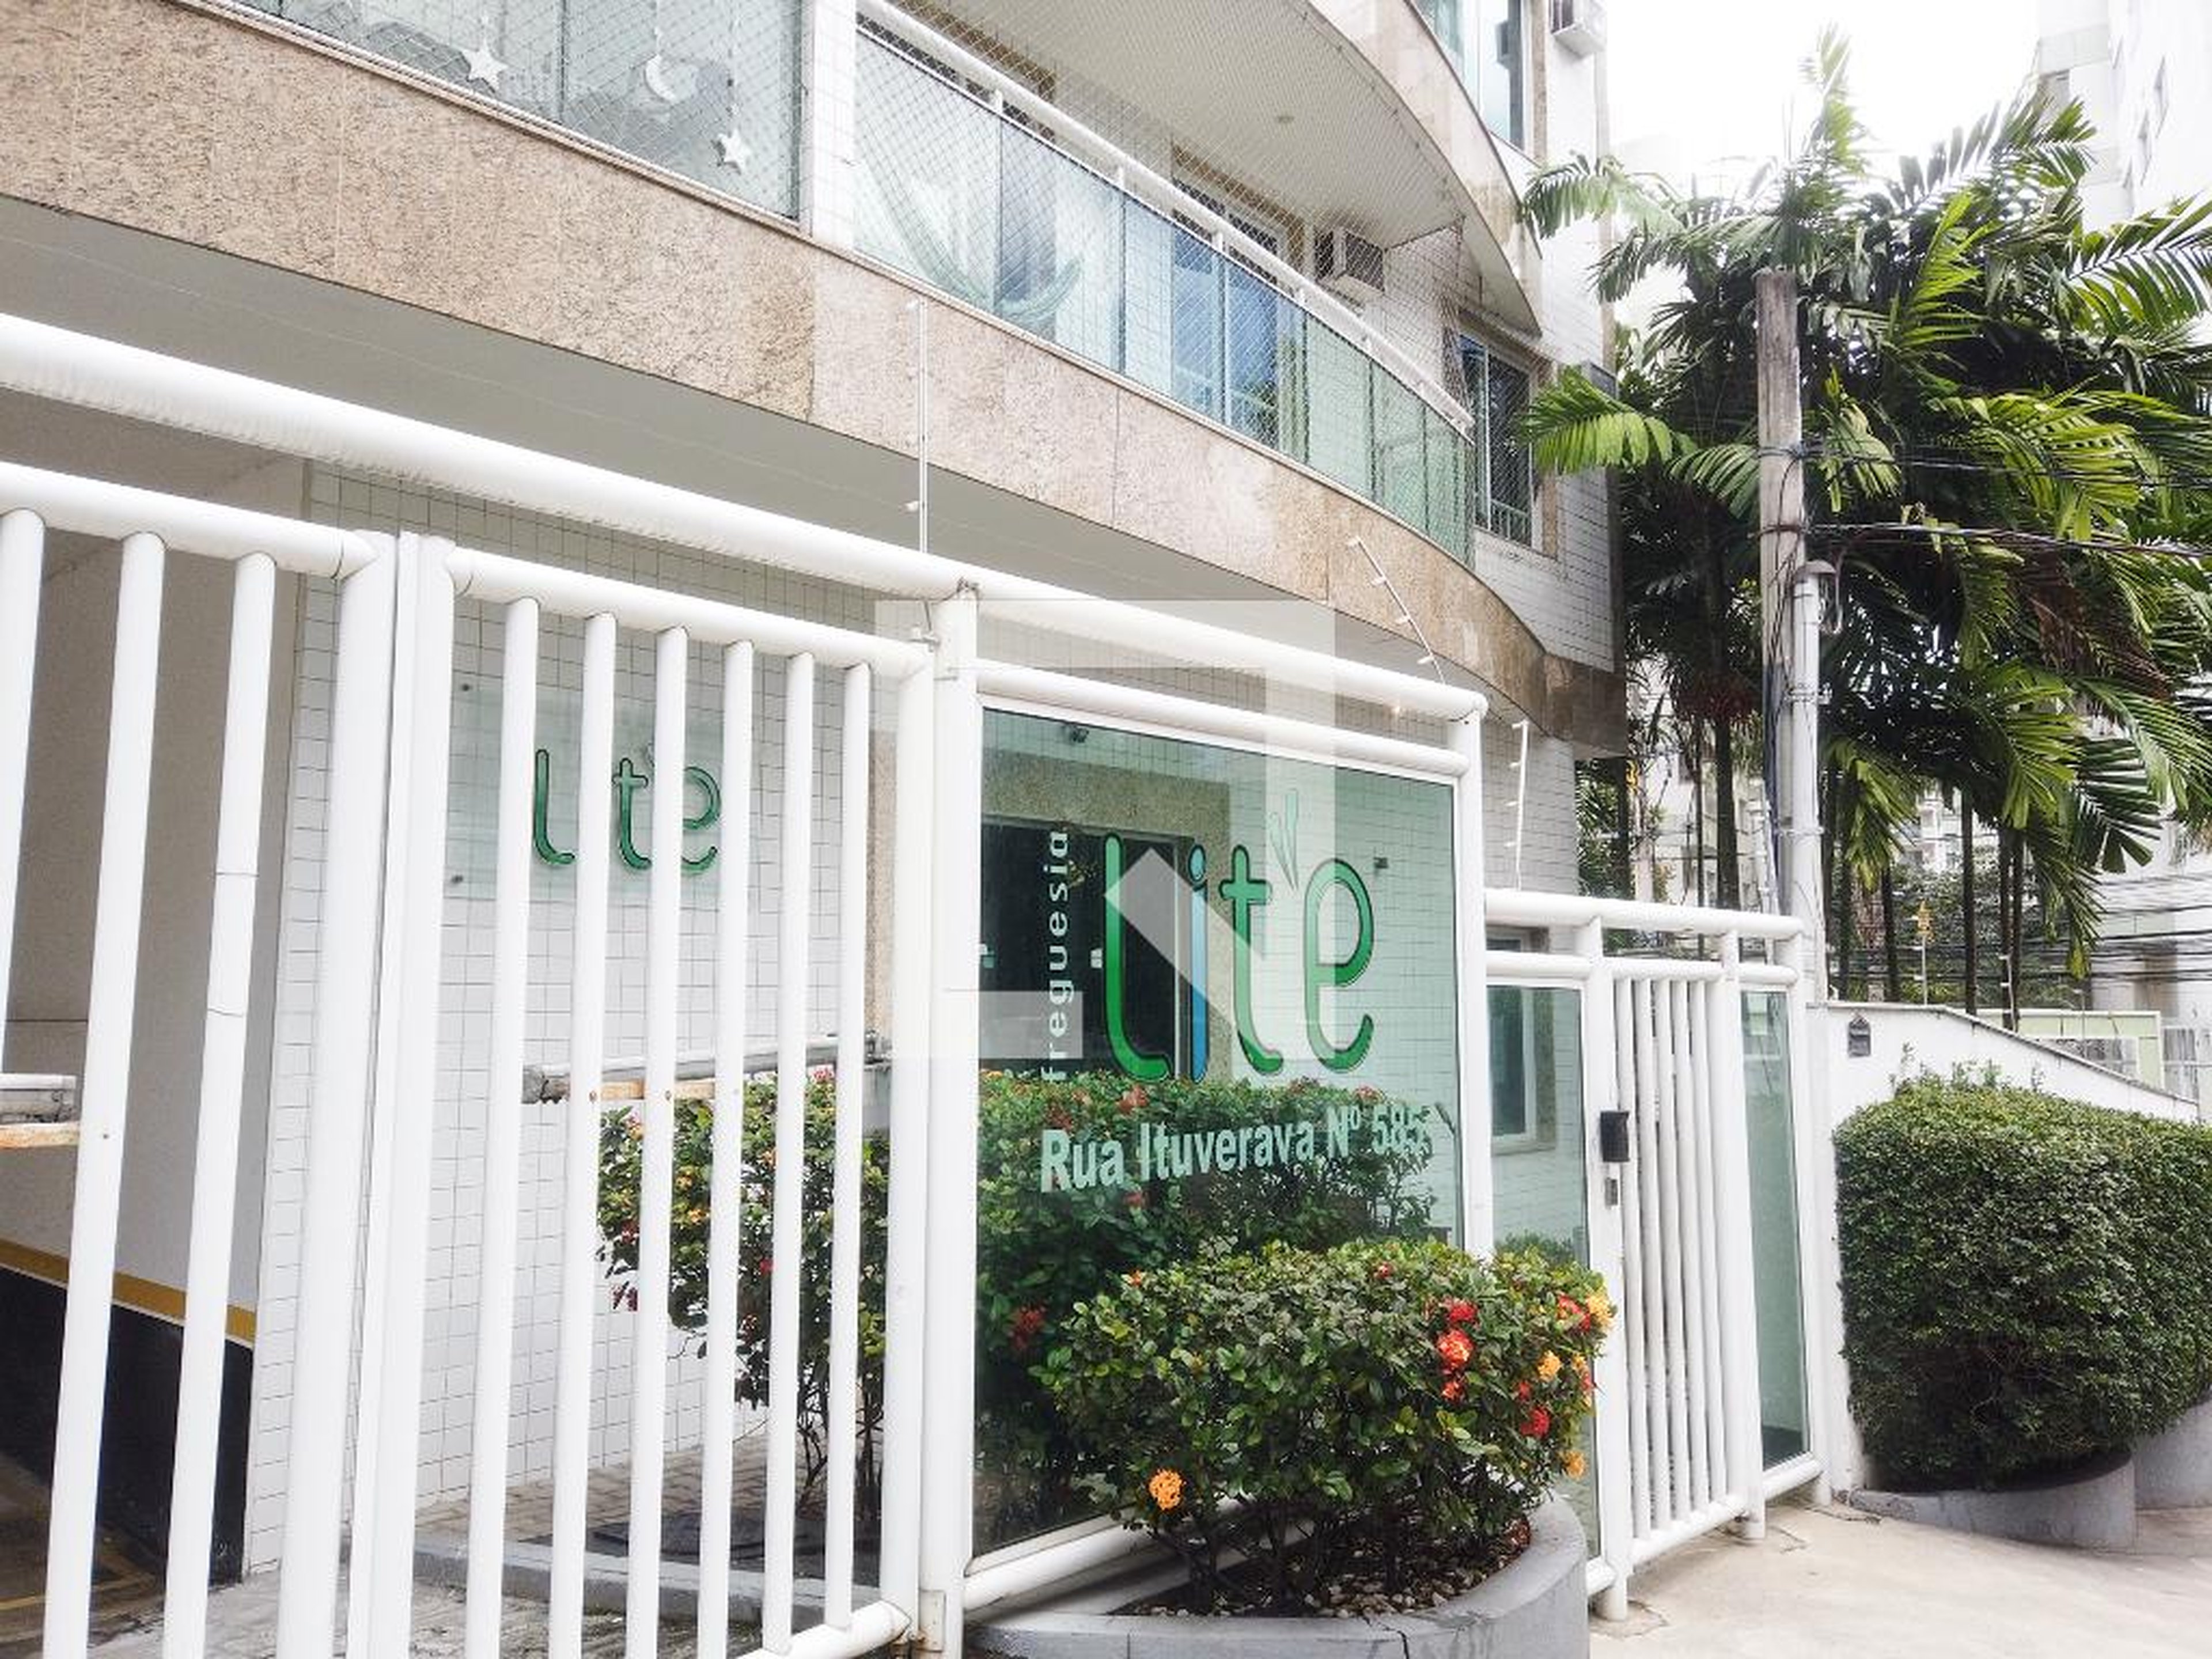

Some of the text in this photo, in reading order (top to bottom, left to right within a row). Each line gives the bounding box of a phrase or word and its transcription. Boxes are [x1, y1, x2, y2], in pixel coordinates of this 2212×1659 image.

[534, 749, 721, 878] Lte
[1040, 831, 1074, 1083] freguesia
[1040, 1129, 1124, 1193] Rua
[1140, 1121, 1314, 1181] Ituverava
[1372, 1104, 1431, 1156] 585
